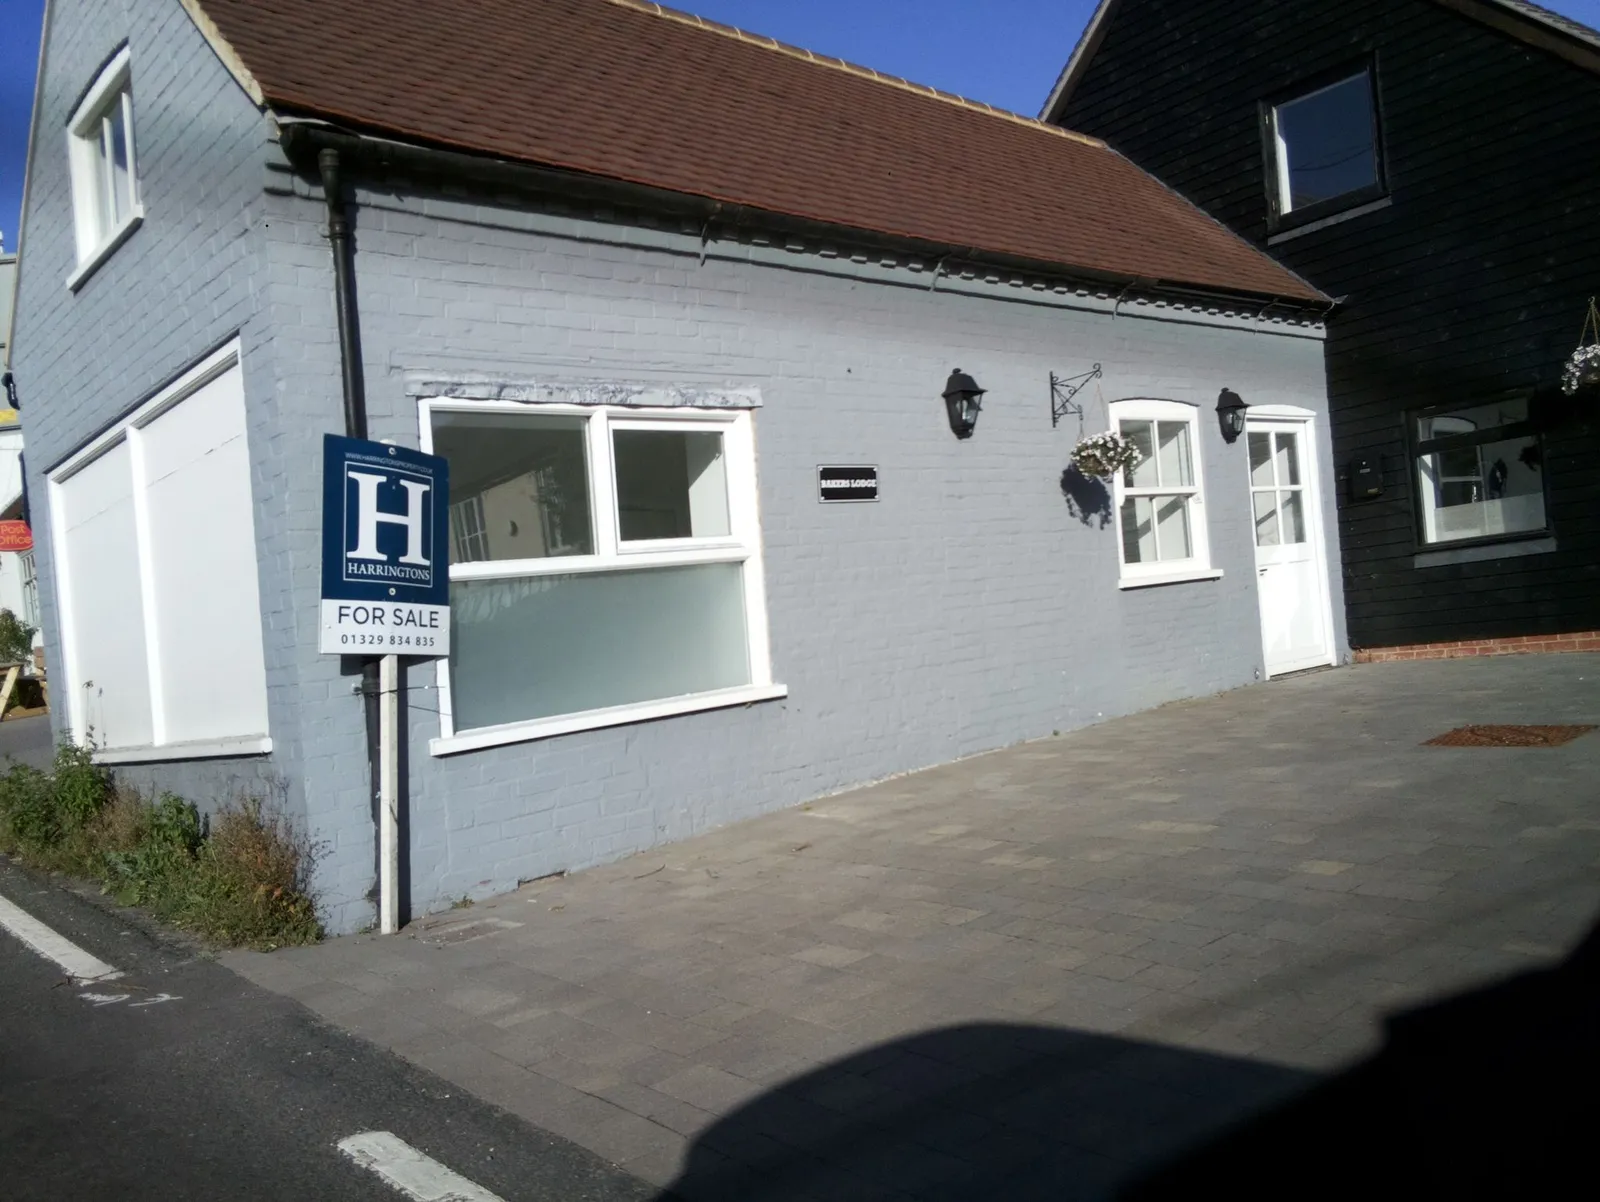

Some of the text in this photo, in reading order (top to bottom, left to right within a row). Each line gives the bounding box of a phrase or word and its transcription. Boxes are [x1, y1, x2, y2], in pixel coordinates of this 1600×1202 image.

[821, 479, 877, 488] BAKERS LODGE
[346, 471, 431, 566] H
[1, 524, 24, 534] Post
[347, 562, 430, 580] HARRINGTONS
[338, 606, 439, 628] FOR SALE
[341, 634, 435, 647] 01329 834 835
